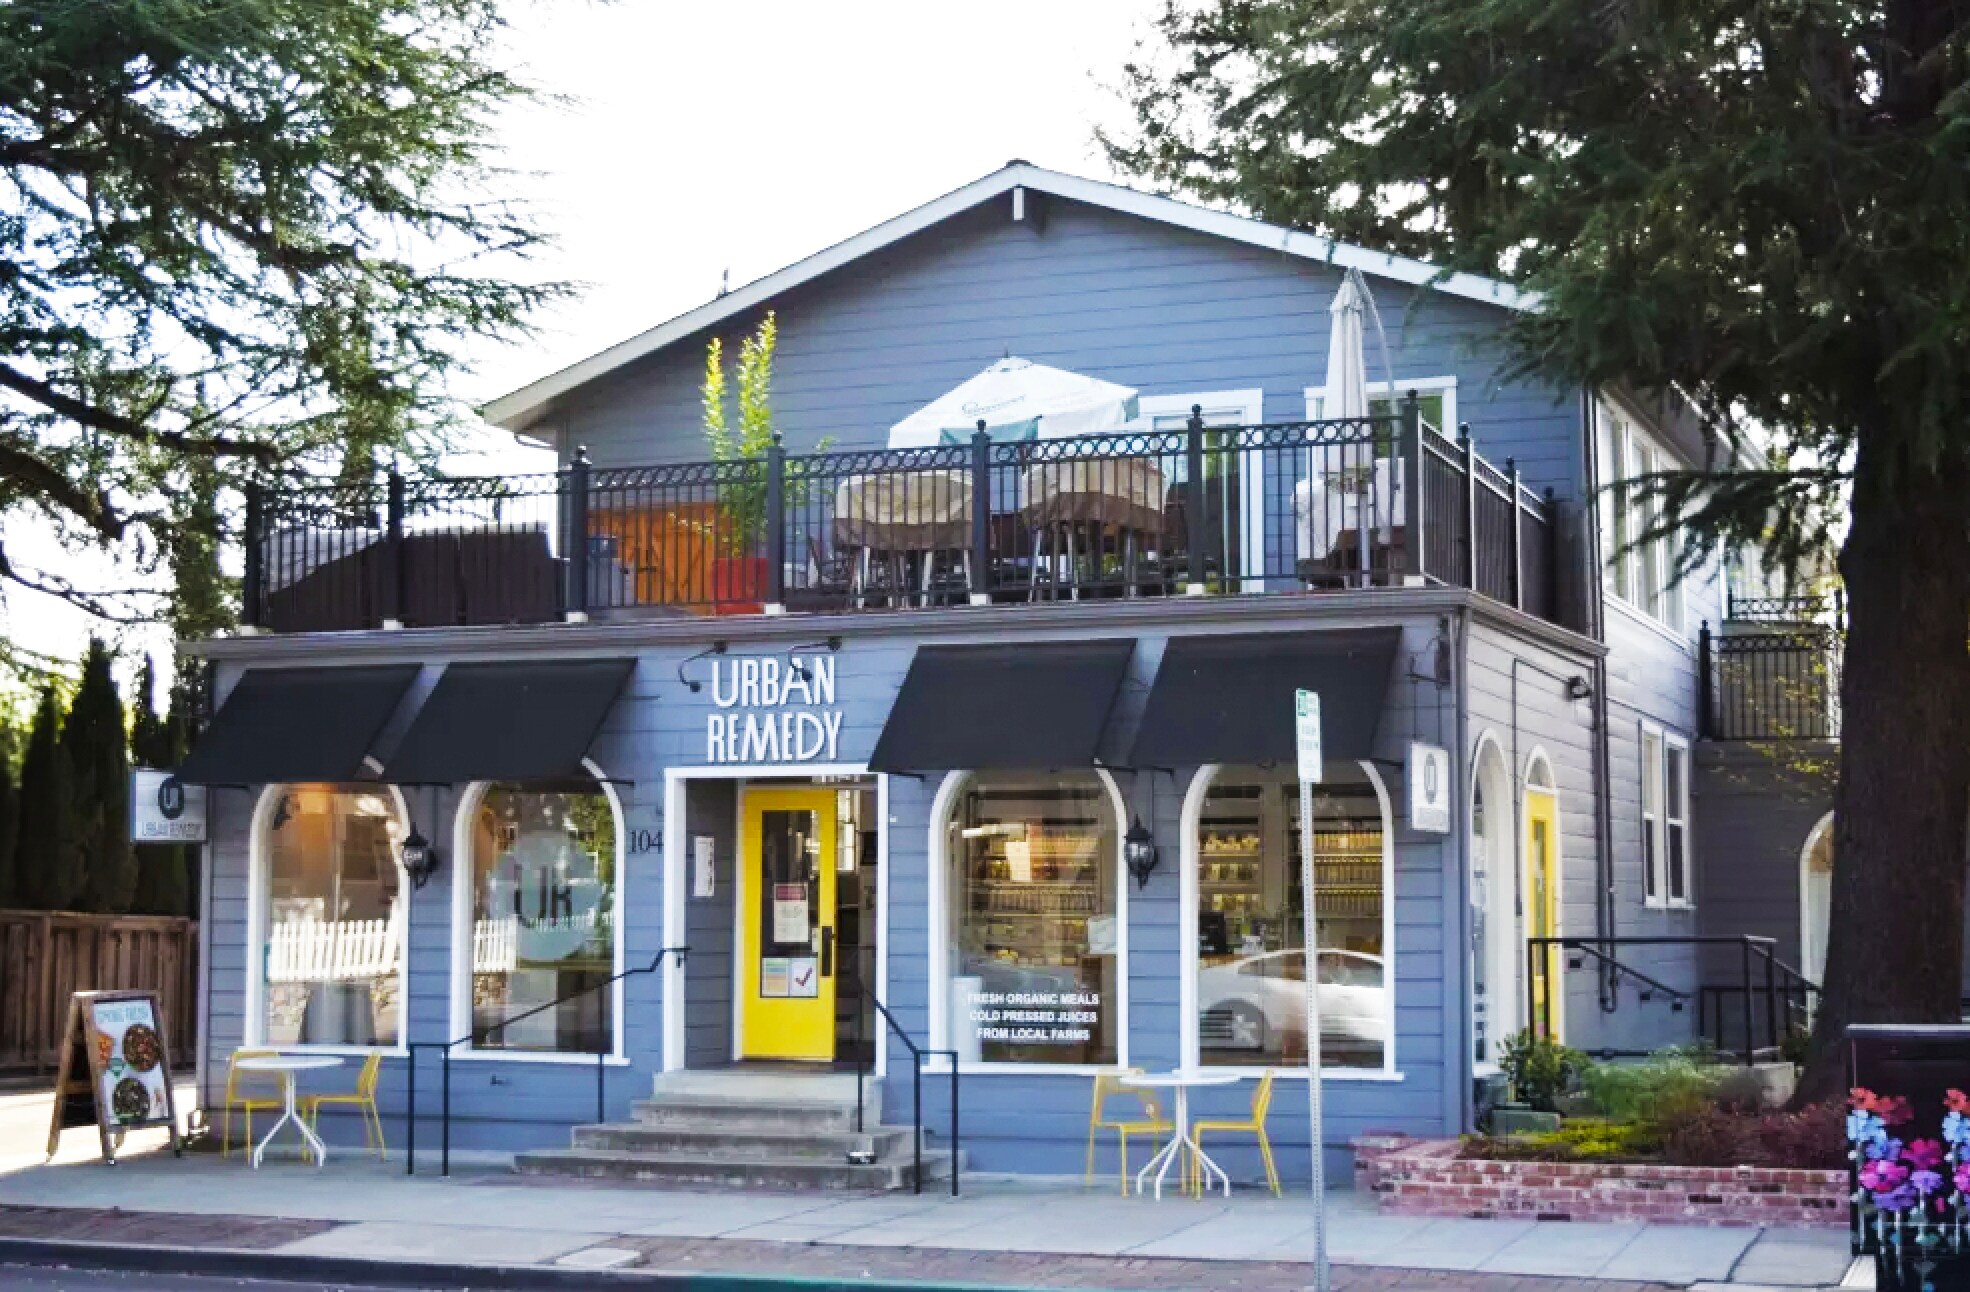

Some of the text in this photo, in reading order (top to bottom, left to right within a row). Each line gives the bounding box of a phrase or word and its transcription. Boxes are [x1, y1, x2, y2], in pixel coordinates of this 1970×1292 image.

[712, 655, 835, 707] URBAN
[707, 711, 843, 762] REMEDY
[628, 829, 664, 855] 104
[968, 992, 1099, 1005] FRESH ORGANIC MEALS
[969, 1009, 1097, 1023] COLD PRESSED JUICES
[975, 1027, 1091, 1040] FROM LOCAL FARMS
